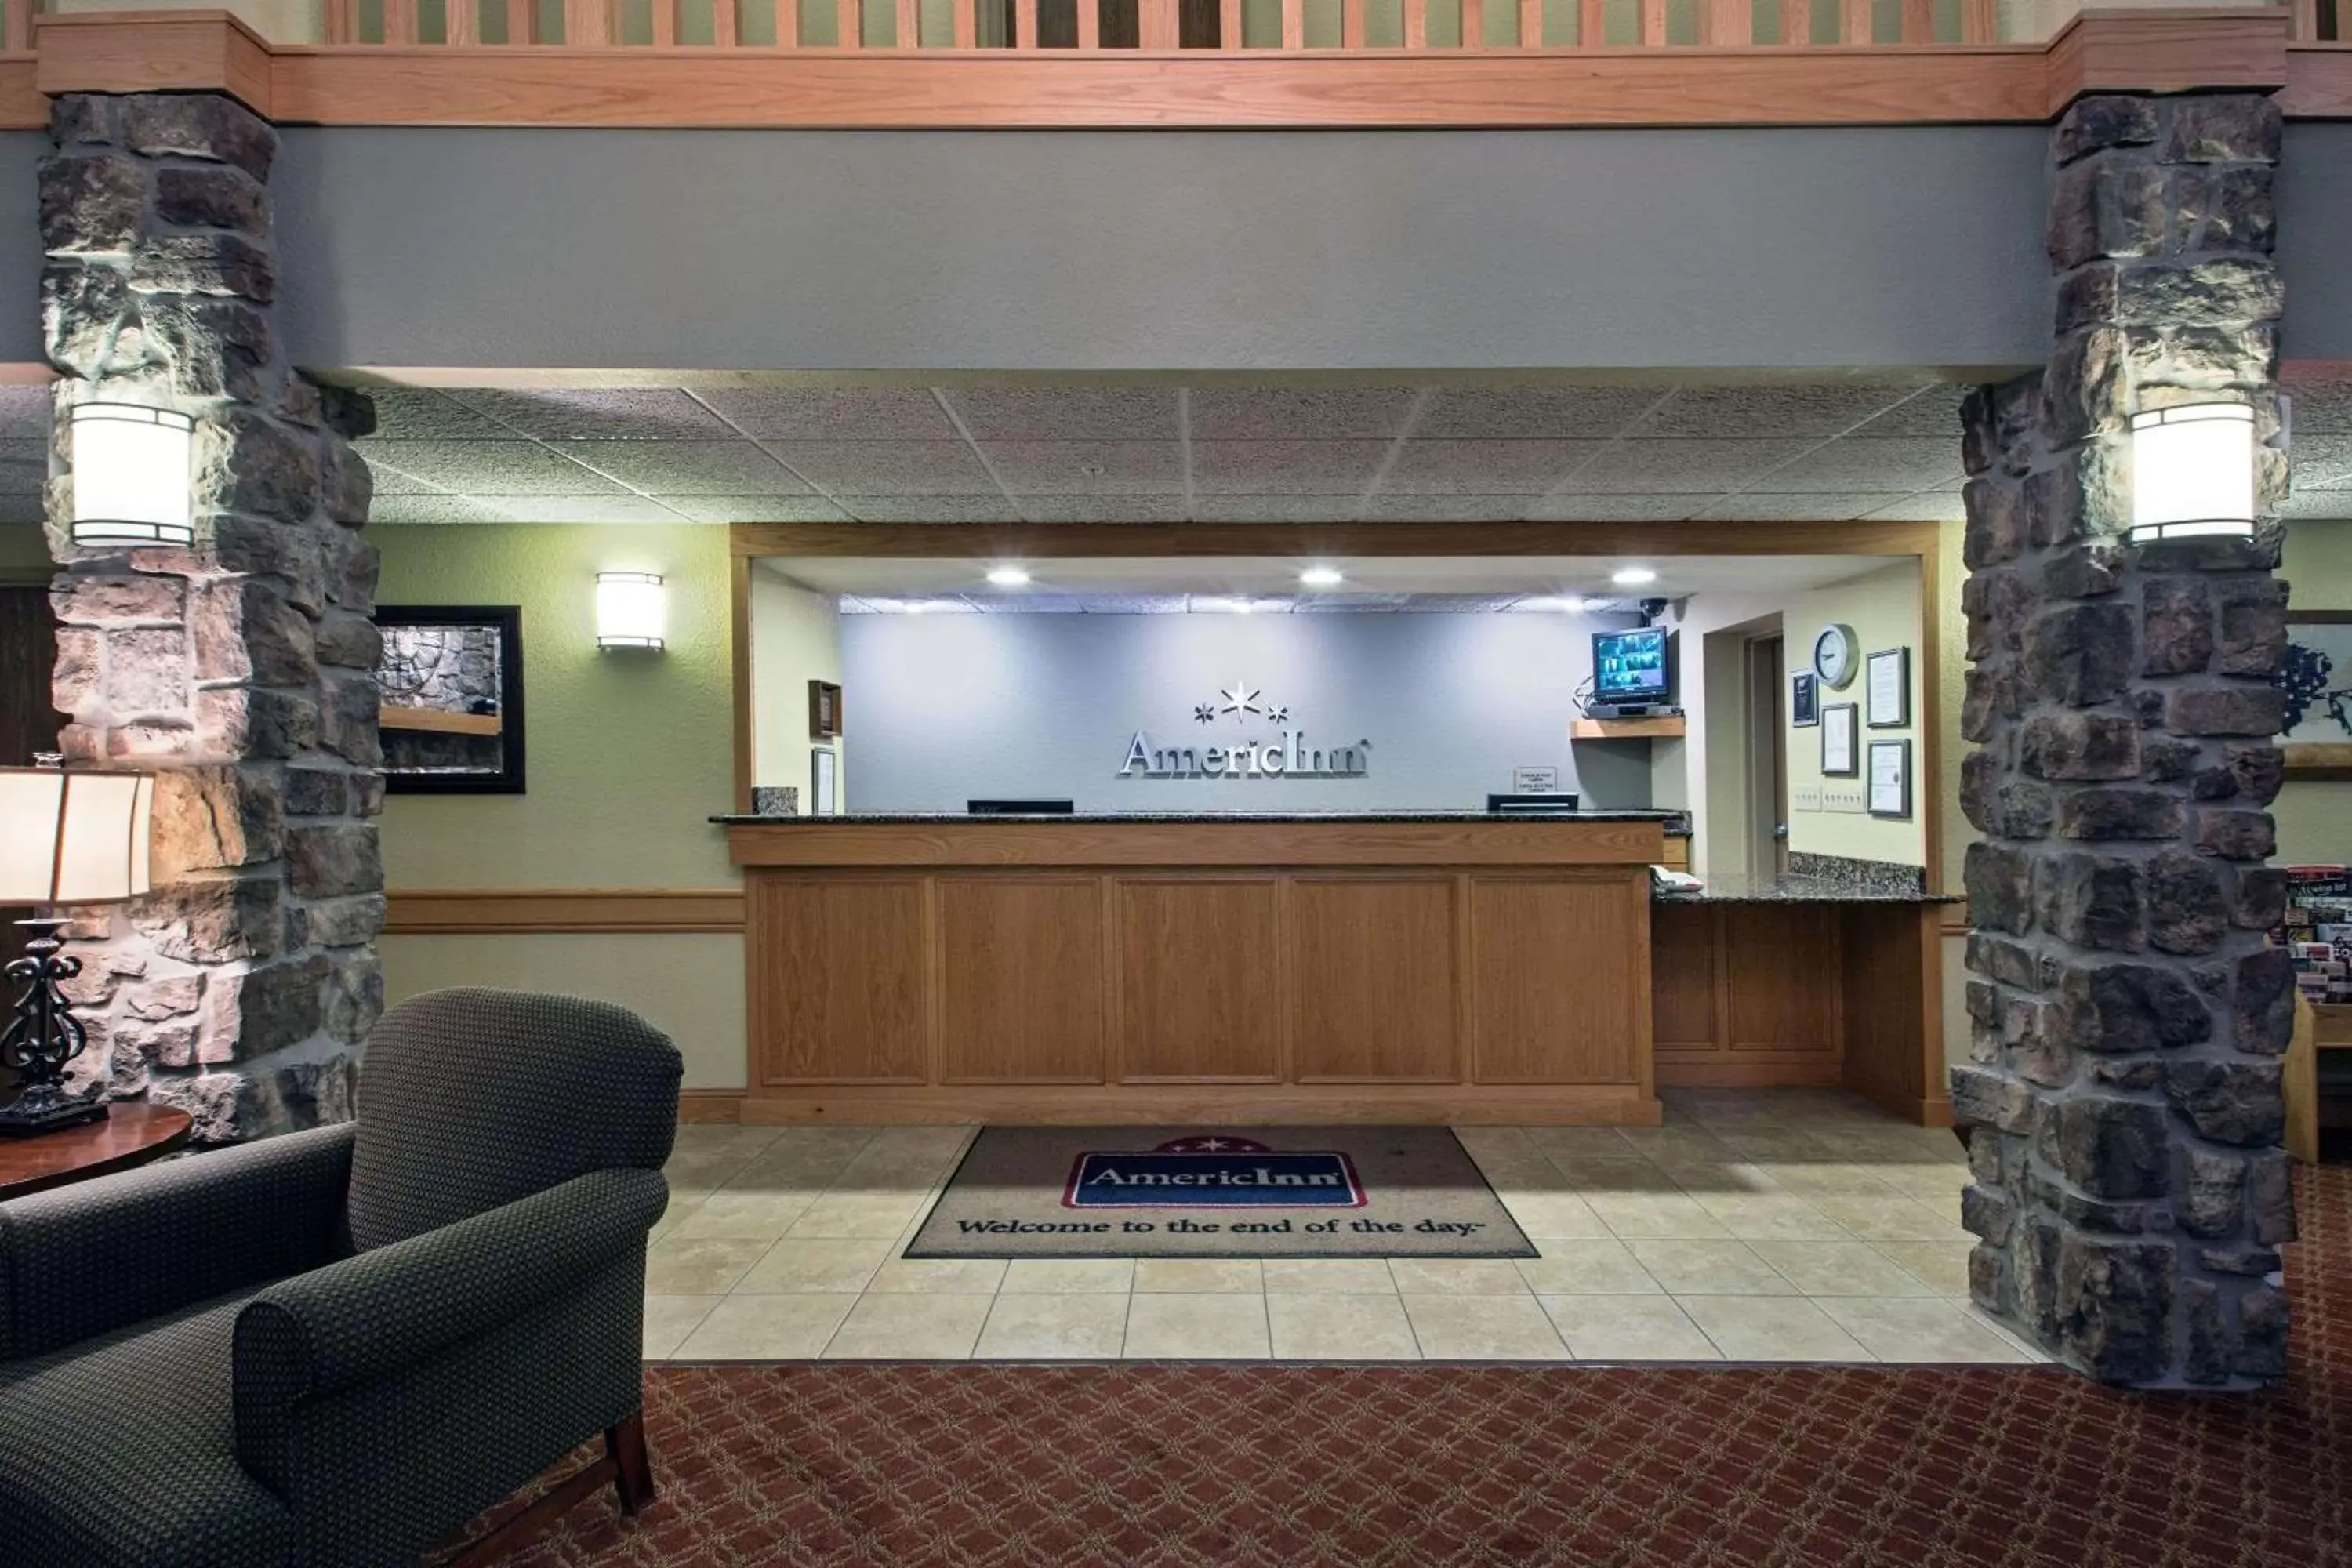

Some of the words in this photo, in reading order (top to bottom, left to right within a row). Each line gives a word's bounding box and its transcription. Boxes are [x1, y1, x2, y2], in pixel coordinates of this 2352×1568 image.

[1117, 728, 1370, 777] AmericInn
[1086, 1167, 1339, 1186] AmericInn
[956, 1219, 1111, 1234] Welcome
[1121, 1220, 1156, 1234] to
[1167, 1219, 1221, 1234] the
[1229, 1219, 1293, 1234] end
[1304, 1219, 1341, 1234] of
[1348, 1219, 1404, 1234] the
